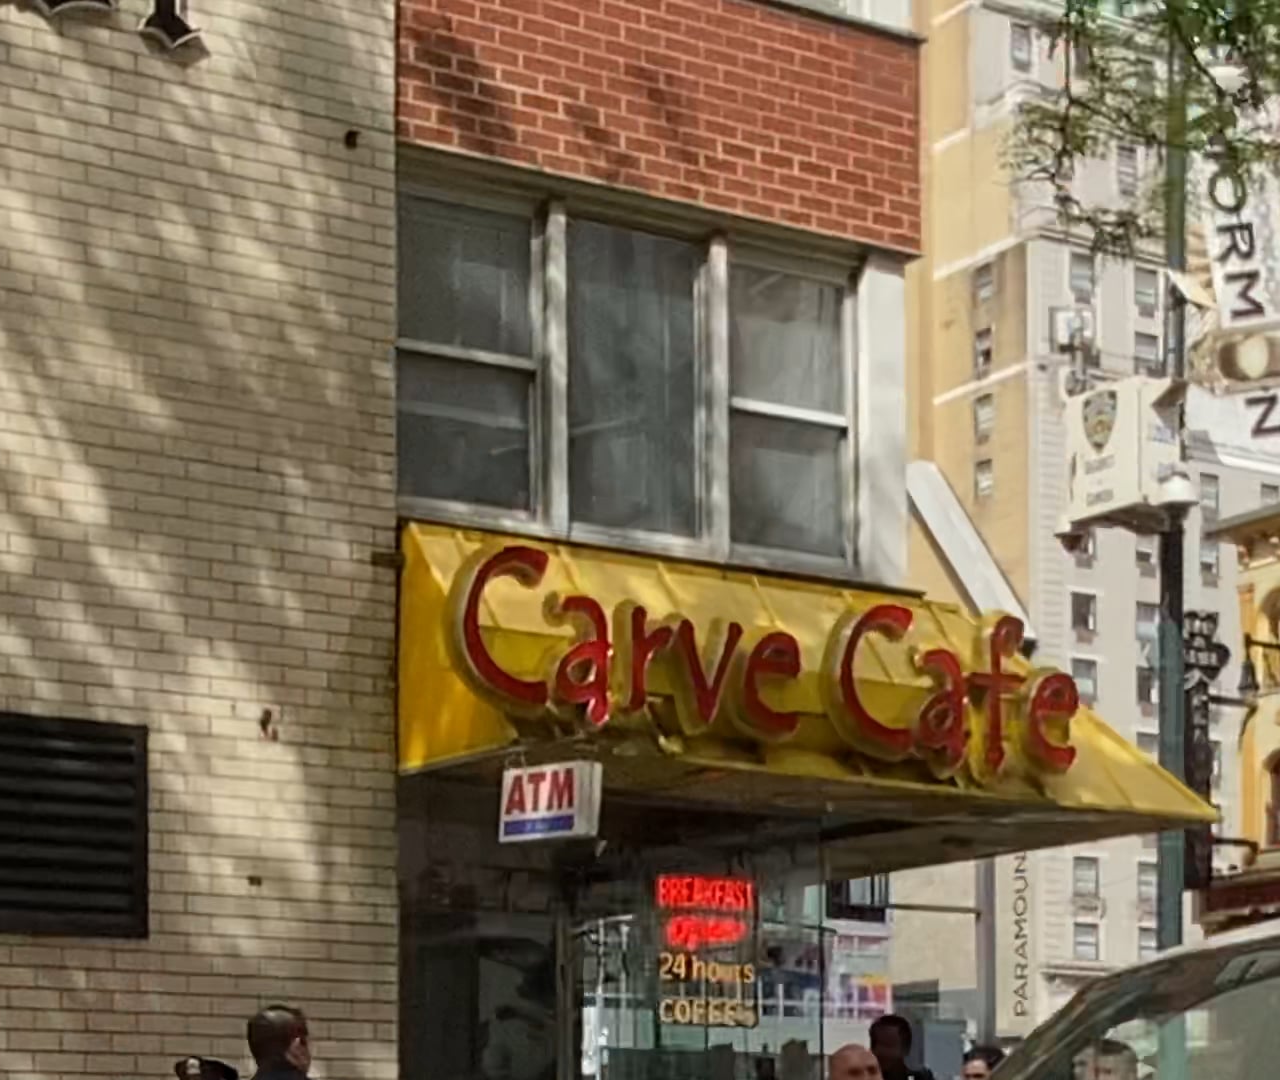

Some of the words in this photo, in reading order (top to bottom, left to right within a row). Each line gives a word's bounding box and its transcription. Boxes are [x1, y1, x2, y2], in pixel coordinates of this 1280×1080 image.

[452, 545, 802, 740] Carve
[828, 604, 1080, 778] Cafe
[504, 767, 574, 815] ATM
[659, 952, 687, 981] 24
[692, 955, 755, 984] hours
